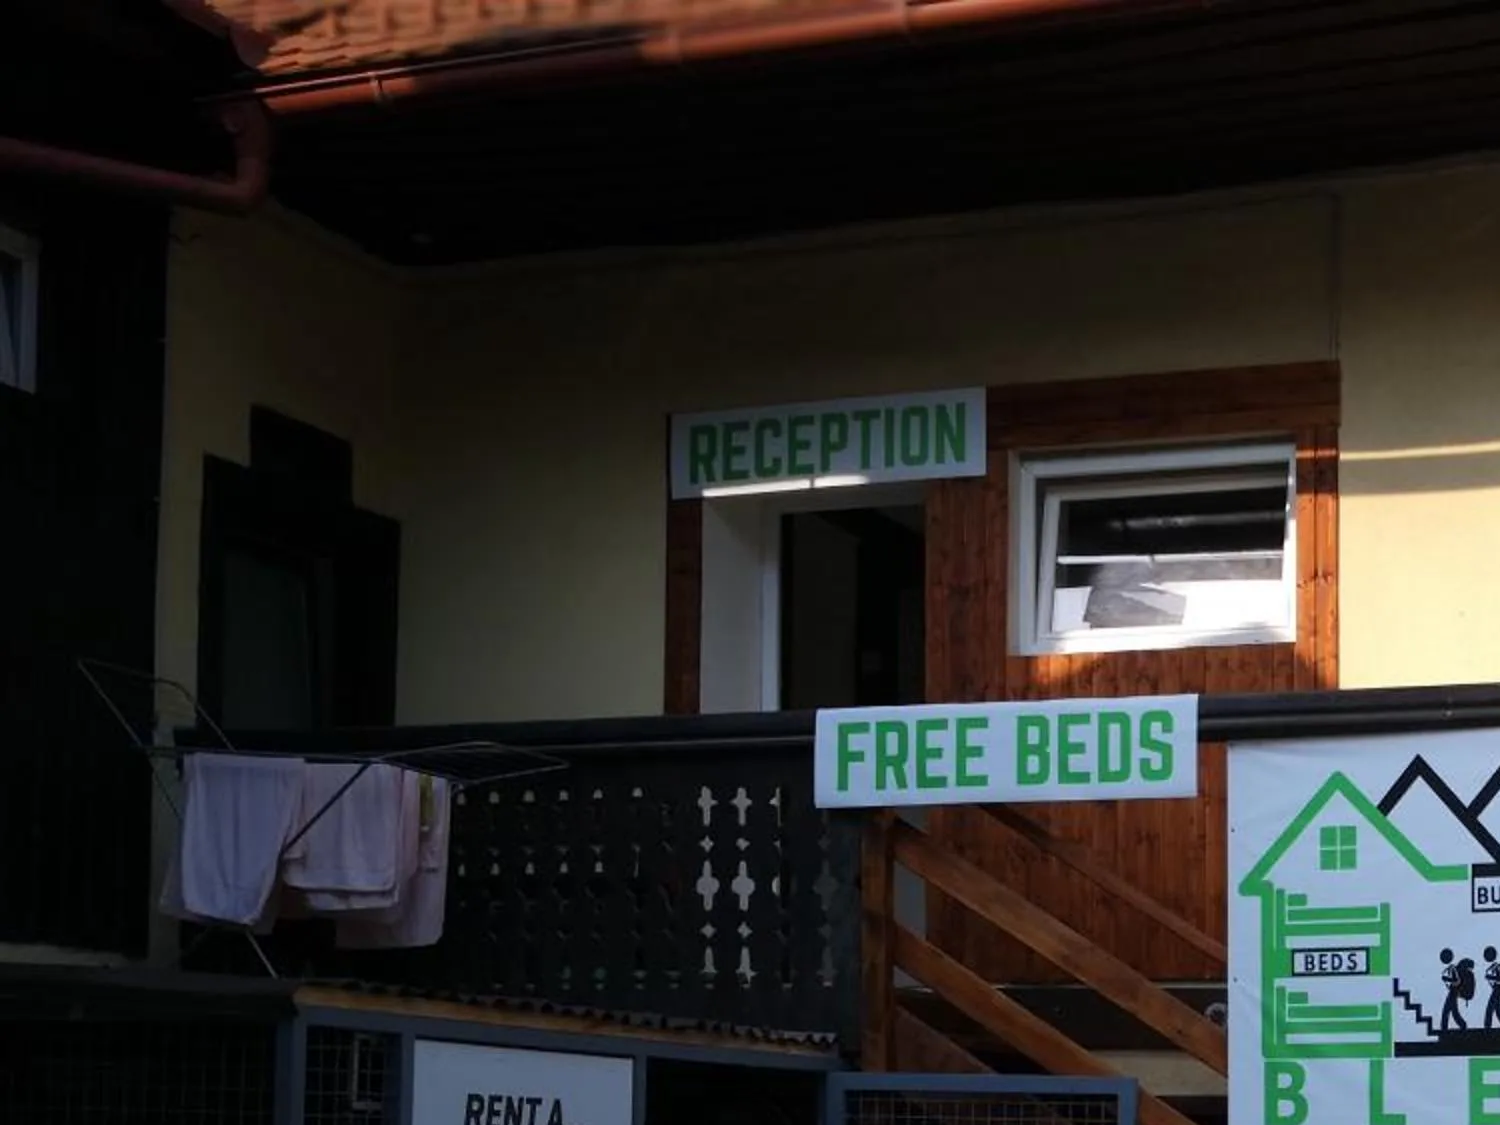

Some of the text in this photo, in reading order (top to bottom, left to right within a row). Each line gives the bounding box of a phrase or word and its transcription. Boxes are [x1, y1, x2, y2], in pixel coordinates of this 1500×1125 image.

[689, 403, 966, 484] RECEPTION
[836, 709, 1175, 791] FREE BEDS
[1303, 953, 1359, 973] BEDS
